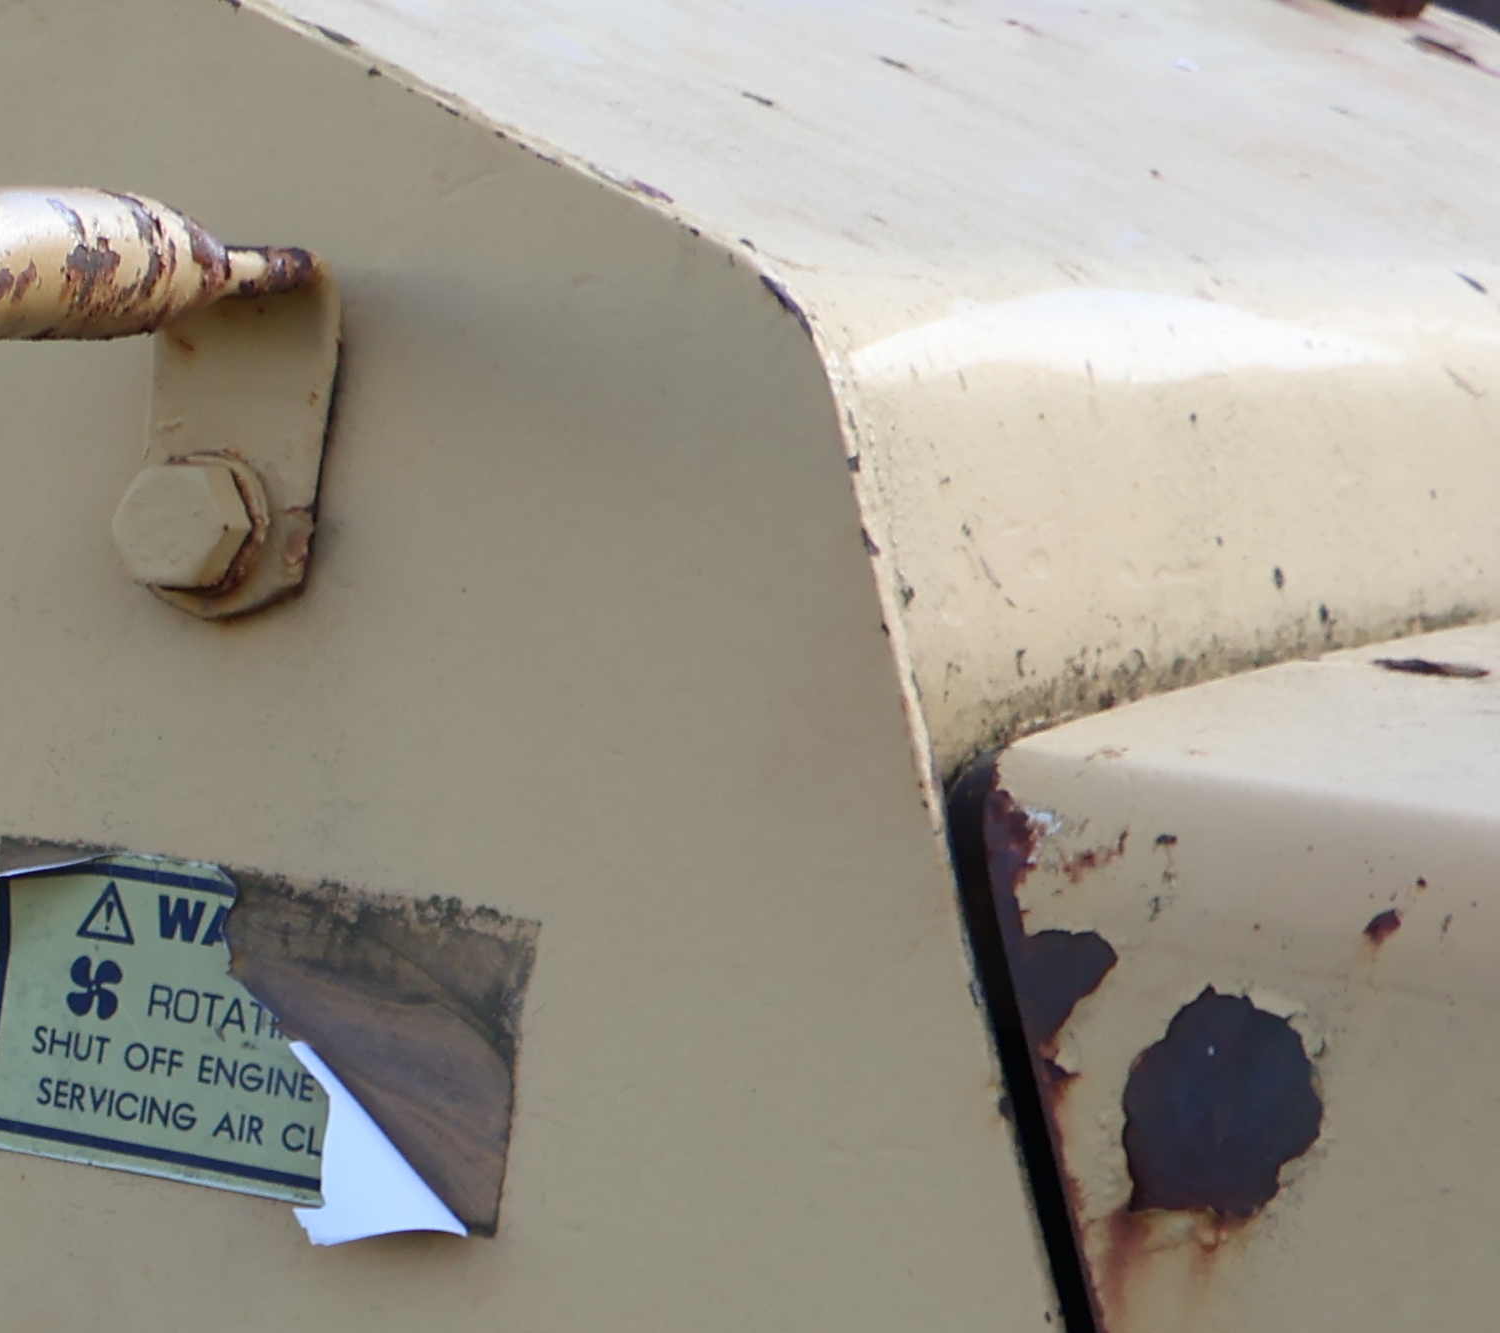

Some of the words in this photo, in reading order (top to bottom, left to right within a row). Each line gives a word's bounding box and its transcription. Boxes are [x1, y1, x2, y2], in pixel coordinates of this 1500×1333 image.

[31, 1025, 111, 1065] SHUT
[123, 1042, 184, 1078] OFF
[196, 1055, 316, 1103] ENGINE
[35, 1077, 197, 1132] SERVICING
[211, 1111, 264, 1146] AIR
[281, 1122, 322, 1157] CL
